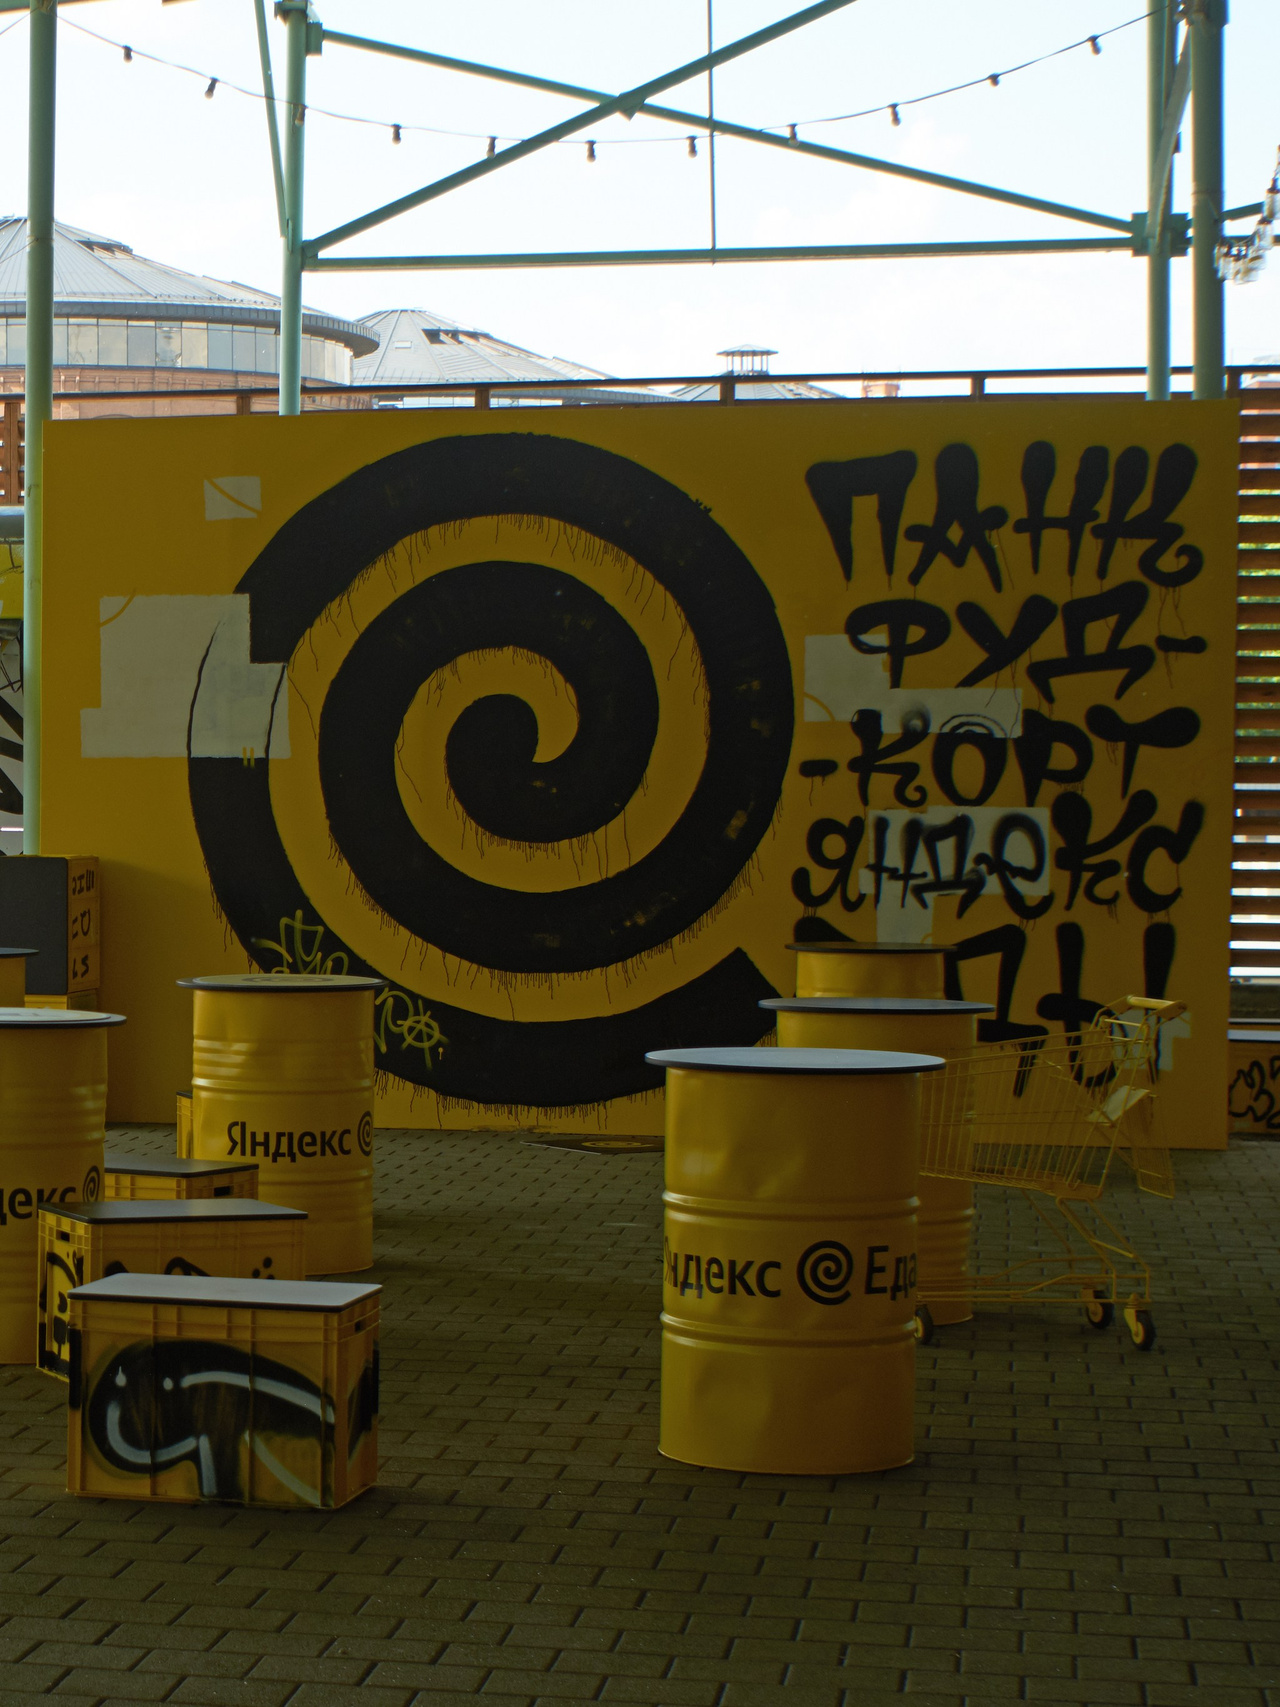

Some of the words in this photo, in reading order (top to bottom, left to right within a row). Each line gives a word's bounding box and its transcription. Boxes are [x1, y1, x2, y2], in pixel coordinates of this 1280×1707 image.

[805, 441, 1204, 593] ПАНК
[227, 1121, 352, 1163] Яндекс
[864, 1245, 918, 1301] Еда
